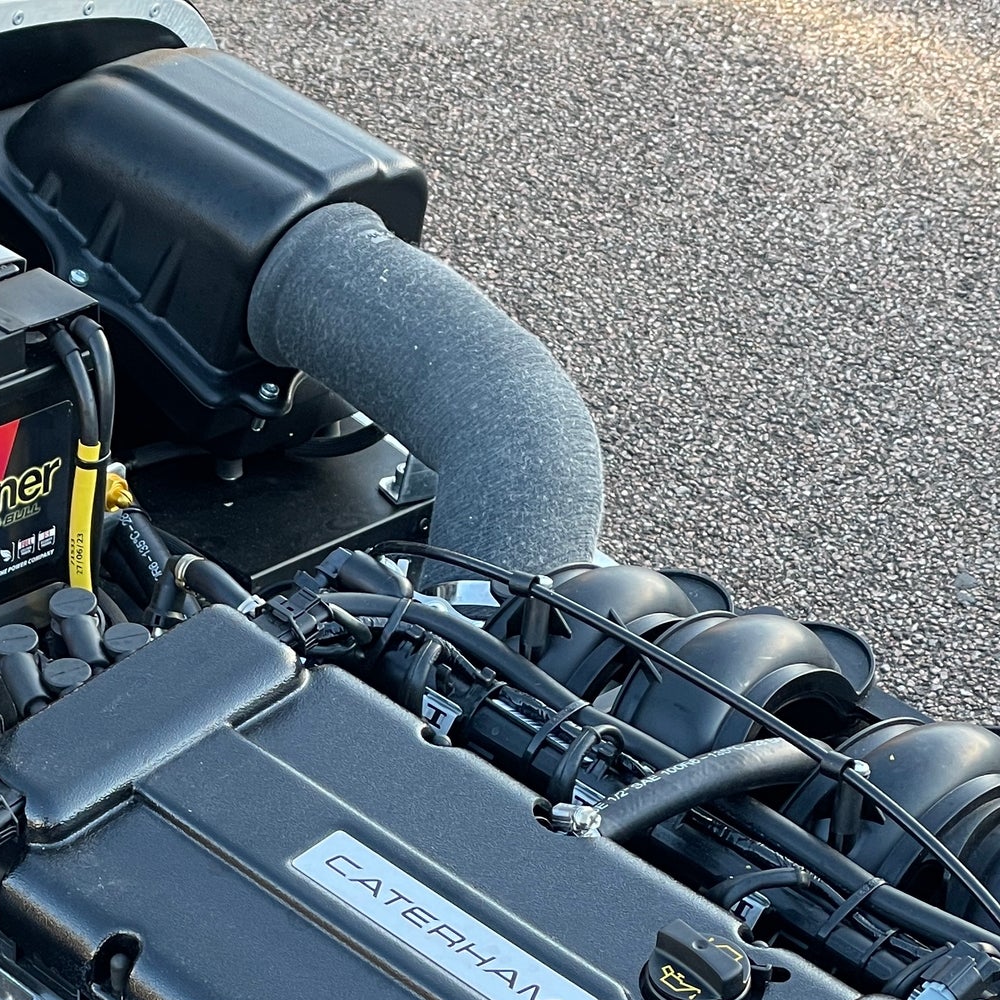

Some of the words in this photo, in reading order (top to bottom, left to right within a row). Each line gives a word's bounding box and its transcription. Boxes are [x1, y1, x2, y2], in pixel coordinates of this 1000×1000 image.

[1, 502, 42, 527] BULL
[7, 559, 29, 574] POWER
[27, 549, 56, 566] COMPANY
[76, 533, 84, 575] 27/06/23
[630, 774, 662, 791] SAE
